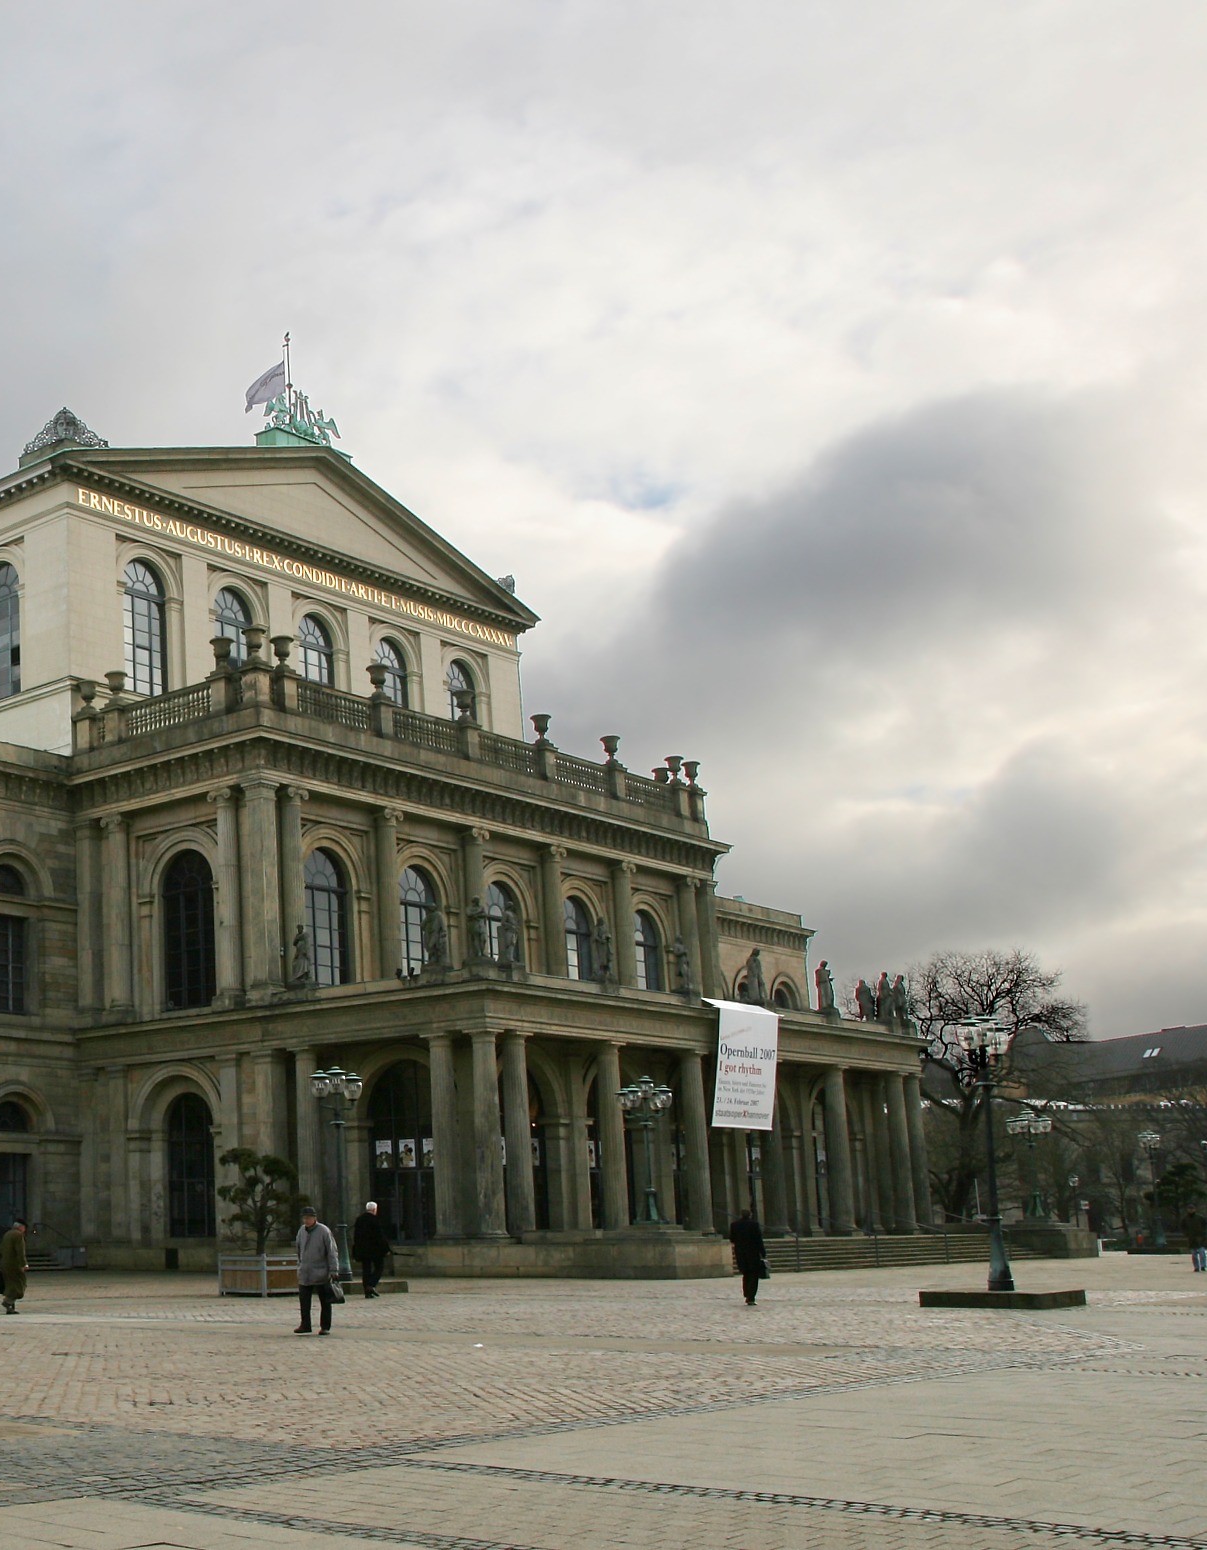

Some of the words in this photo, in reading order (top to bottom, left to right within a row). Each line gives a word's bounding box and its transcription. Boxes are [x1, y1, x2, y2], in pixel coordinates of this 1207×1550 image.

[77, 487, 162, 530] ERNESTUS
[166, 519, 242, 557] AUGUSTUS
[253, 548, 281, 570] REX
[283, 559, 348, 593] CONDIDIT
[349, 581, 378, 603] ARTI
[381, 592, 398, 609] ET
[399, 599, 434, 621] MUSIS
[720, 1042, 758, 1060] Opernball
[759, 1048, 775, 1060] 2007
[719, 1060, 723, 1071] I
[724, 1063, 737, 1076] got
[738, 1063, 762, 1077] rhythm
